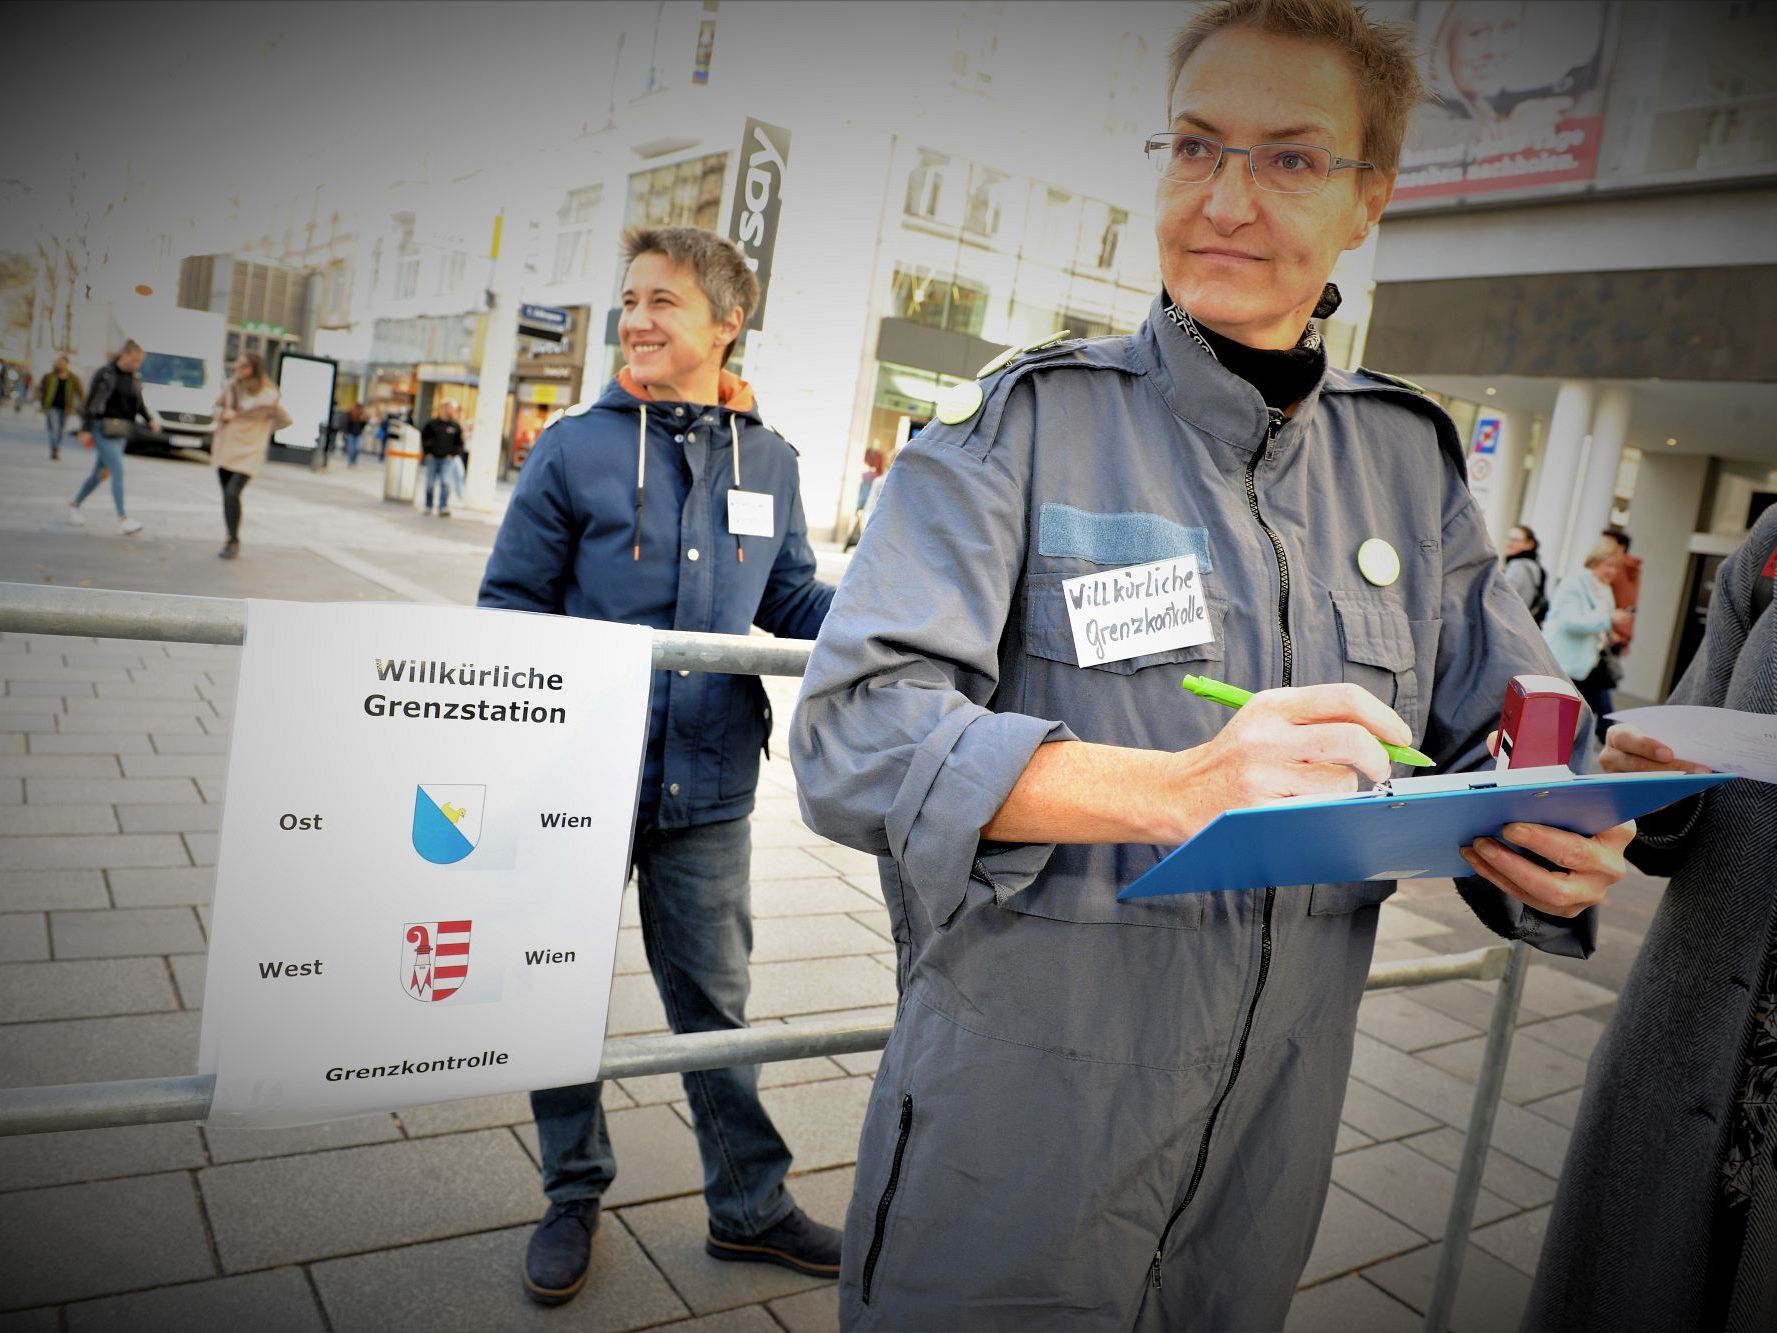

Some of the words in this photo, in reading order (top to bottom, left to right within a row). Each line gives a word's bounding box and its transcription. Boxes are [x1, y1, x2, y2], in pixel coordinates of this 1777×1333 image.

[736, 126, 786, 272] rsay
[1068, 565, 1194, 611] Willkürliche
[375, 659, 563, 691] Willkürliche
[364, 695, 566, 724] Grenzstation
[279, 812, 323, 831] Ost
[540, 812, 593, 829] Wien
[258, 959, 323, 979] West
[525, 949, 576, 966] Wien
[325, 1050, 509, 1082] Grenzkontrolle
